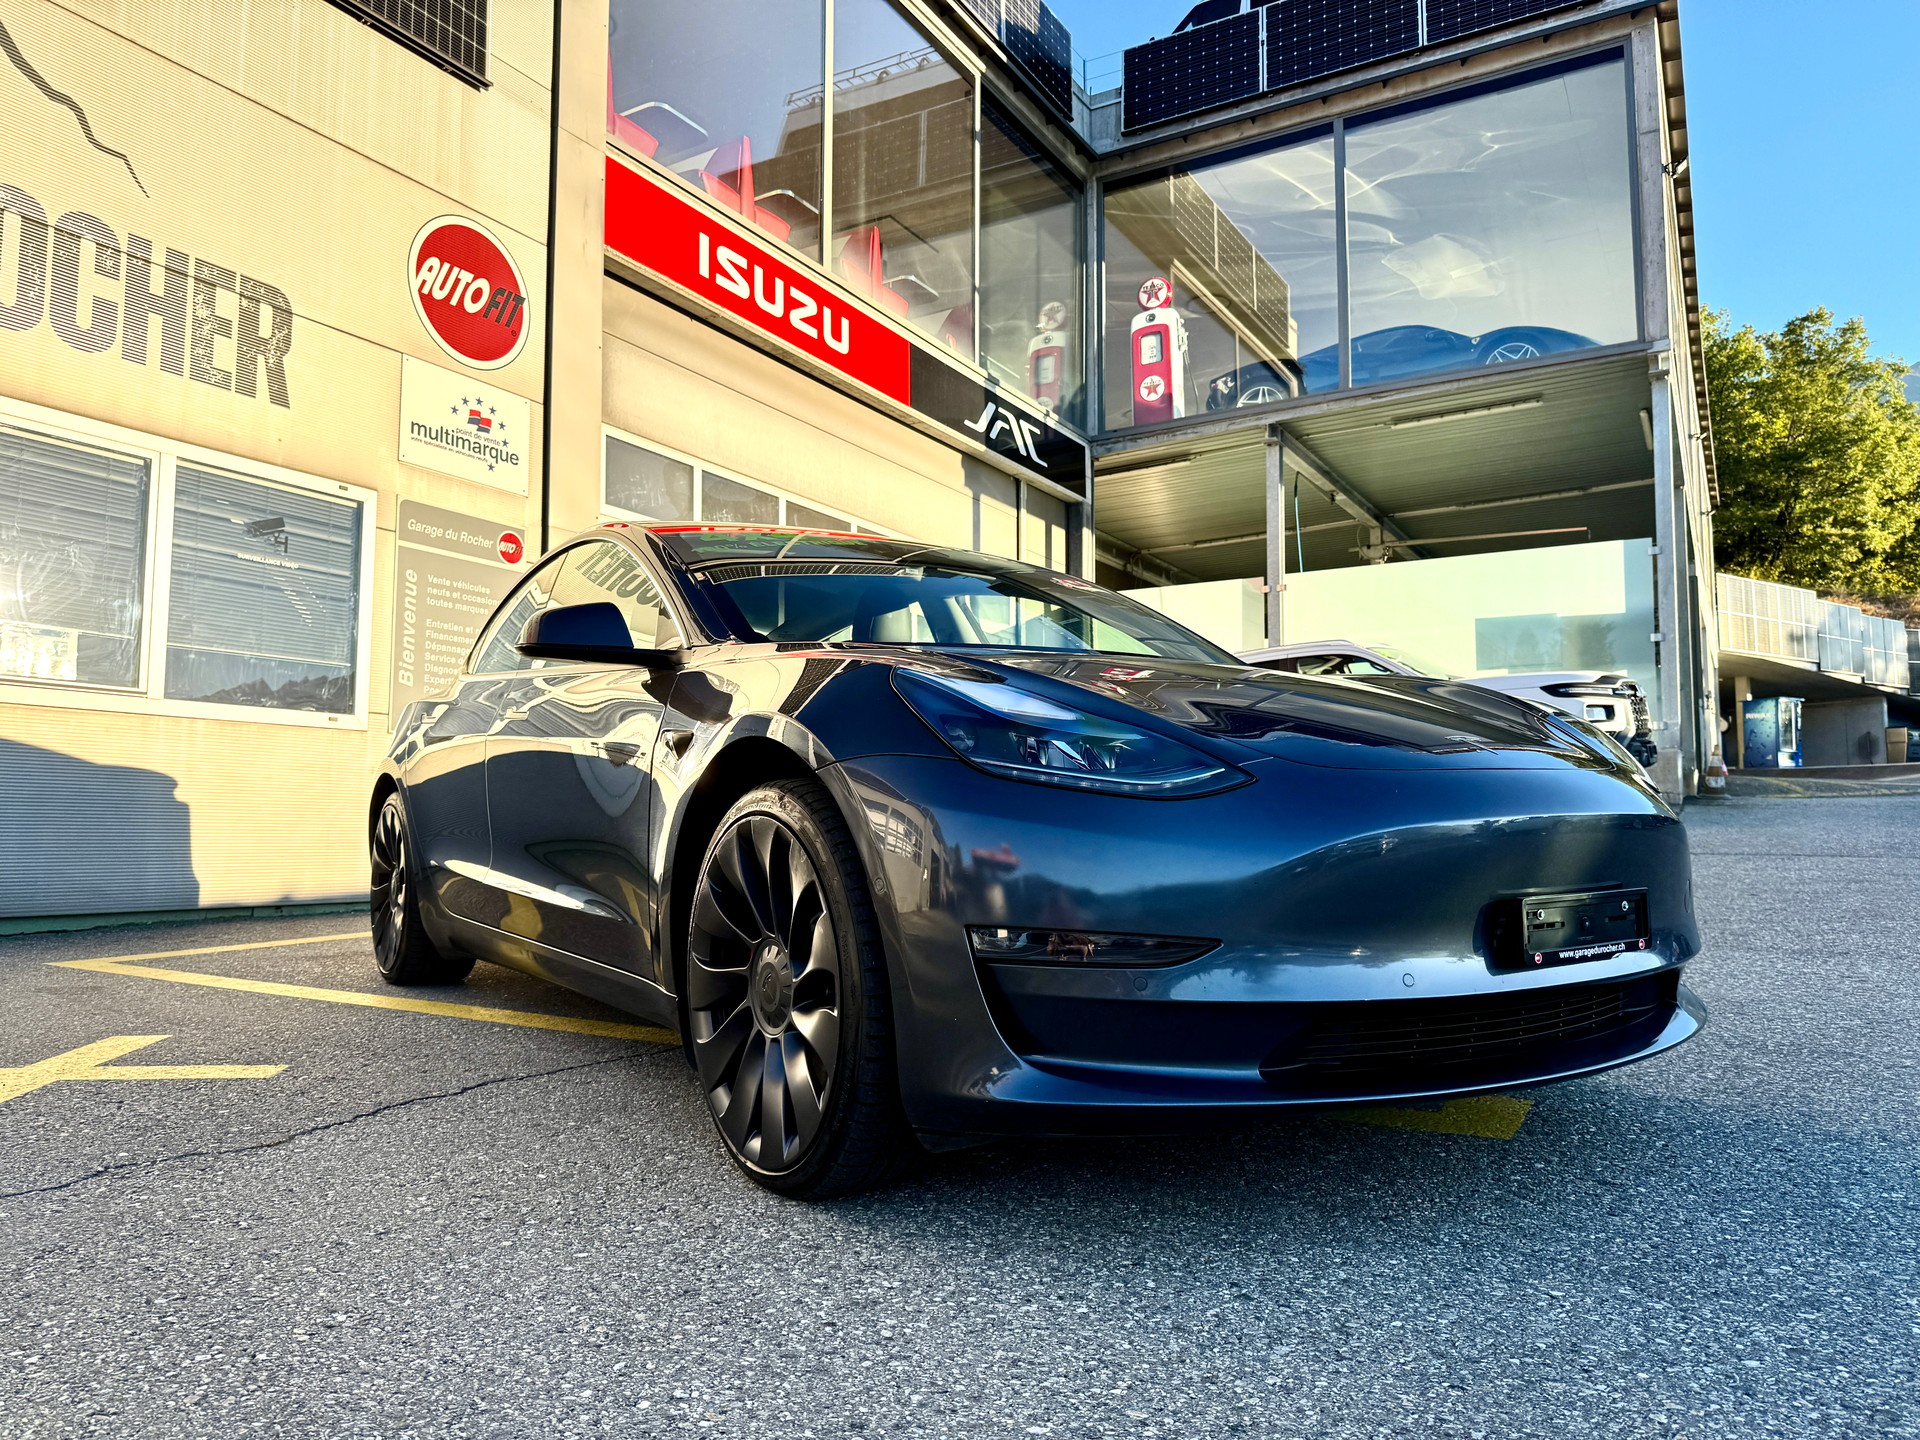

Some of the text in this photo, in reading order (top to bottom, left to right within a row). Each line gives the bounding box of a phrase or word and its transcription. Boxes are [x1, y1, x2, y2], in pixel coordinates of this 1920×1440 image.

[699, 232, 849, 354] ISUZU
[410, 421, 519, 465] multimarque
[456, 427, 501, 446] point de vente
[963, 401, 1048, 467] JAC
[408, 519, 494, 549] Garage du Rocher
[428, 574, 490, 594] Vente véhicules
[427, 587, 450, 598] neufs
[452, 591, 461, 600] et
[427, 597, 489, 615] toutes marques
[398, 569, 417, 687] Bienvenue
[426, 619, 463, 632] Entretien
[425, 630, 475, 645] Financemen
[424, 652, 456, 664] Service
[424, 663, 459, 675] Diagnos
[424, 674, 453, 686] Expert
[1559, 942, 1626, 959] www.garagedurocher.ch
